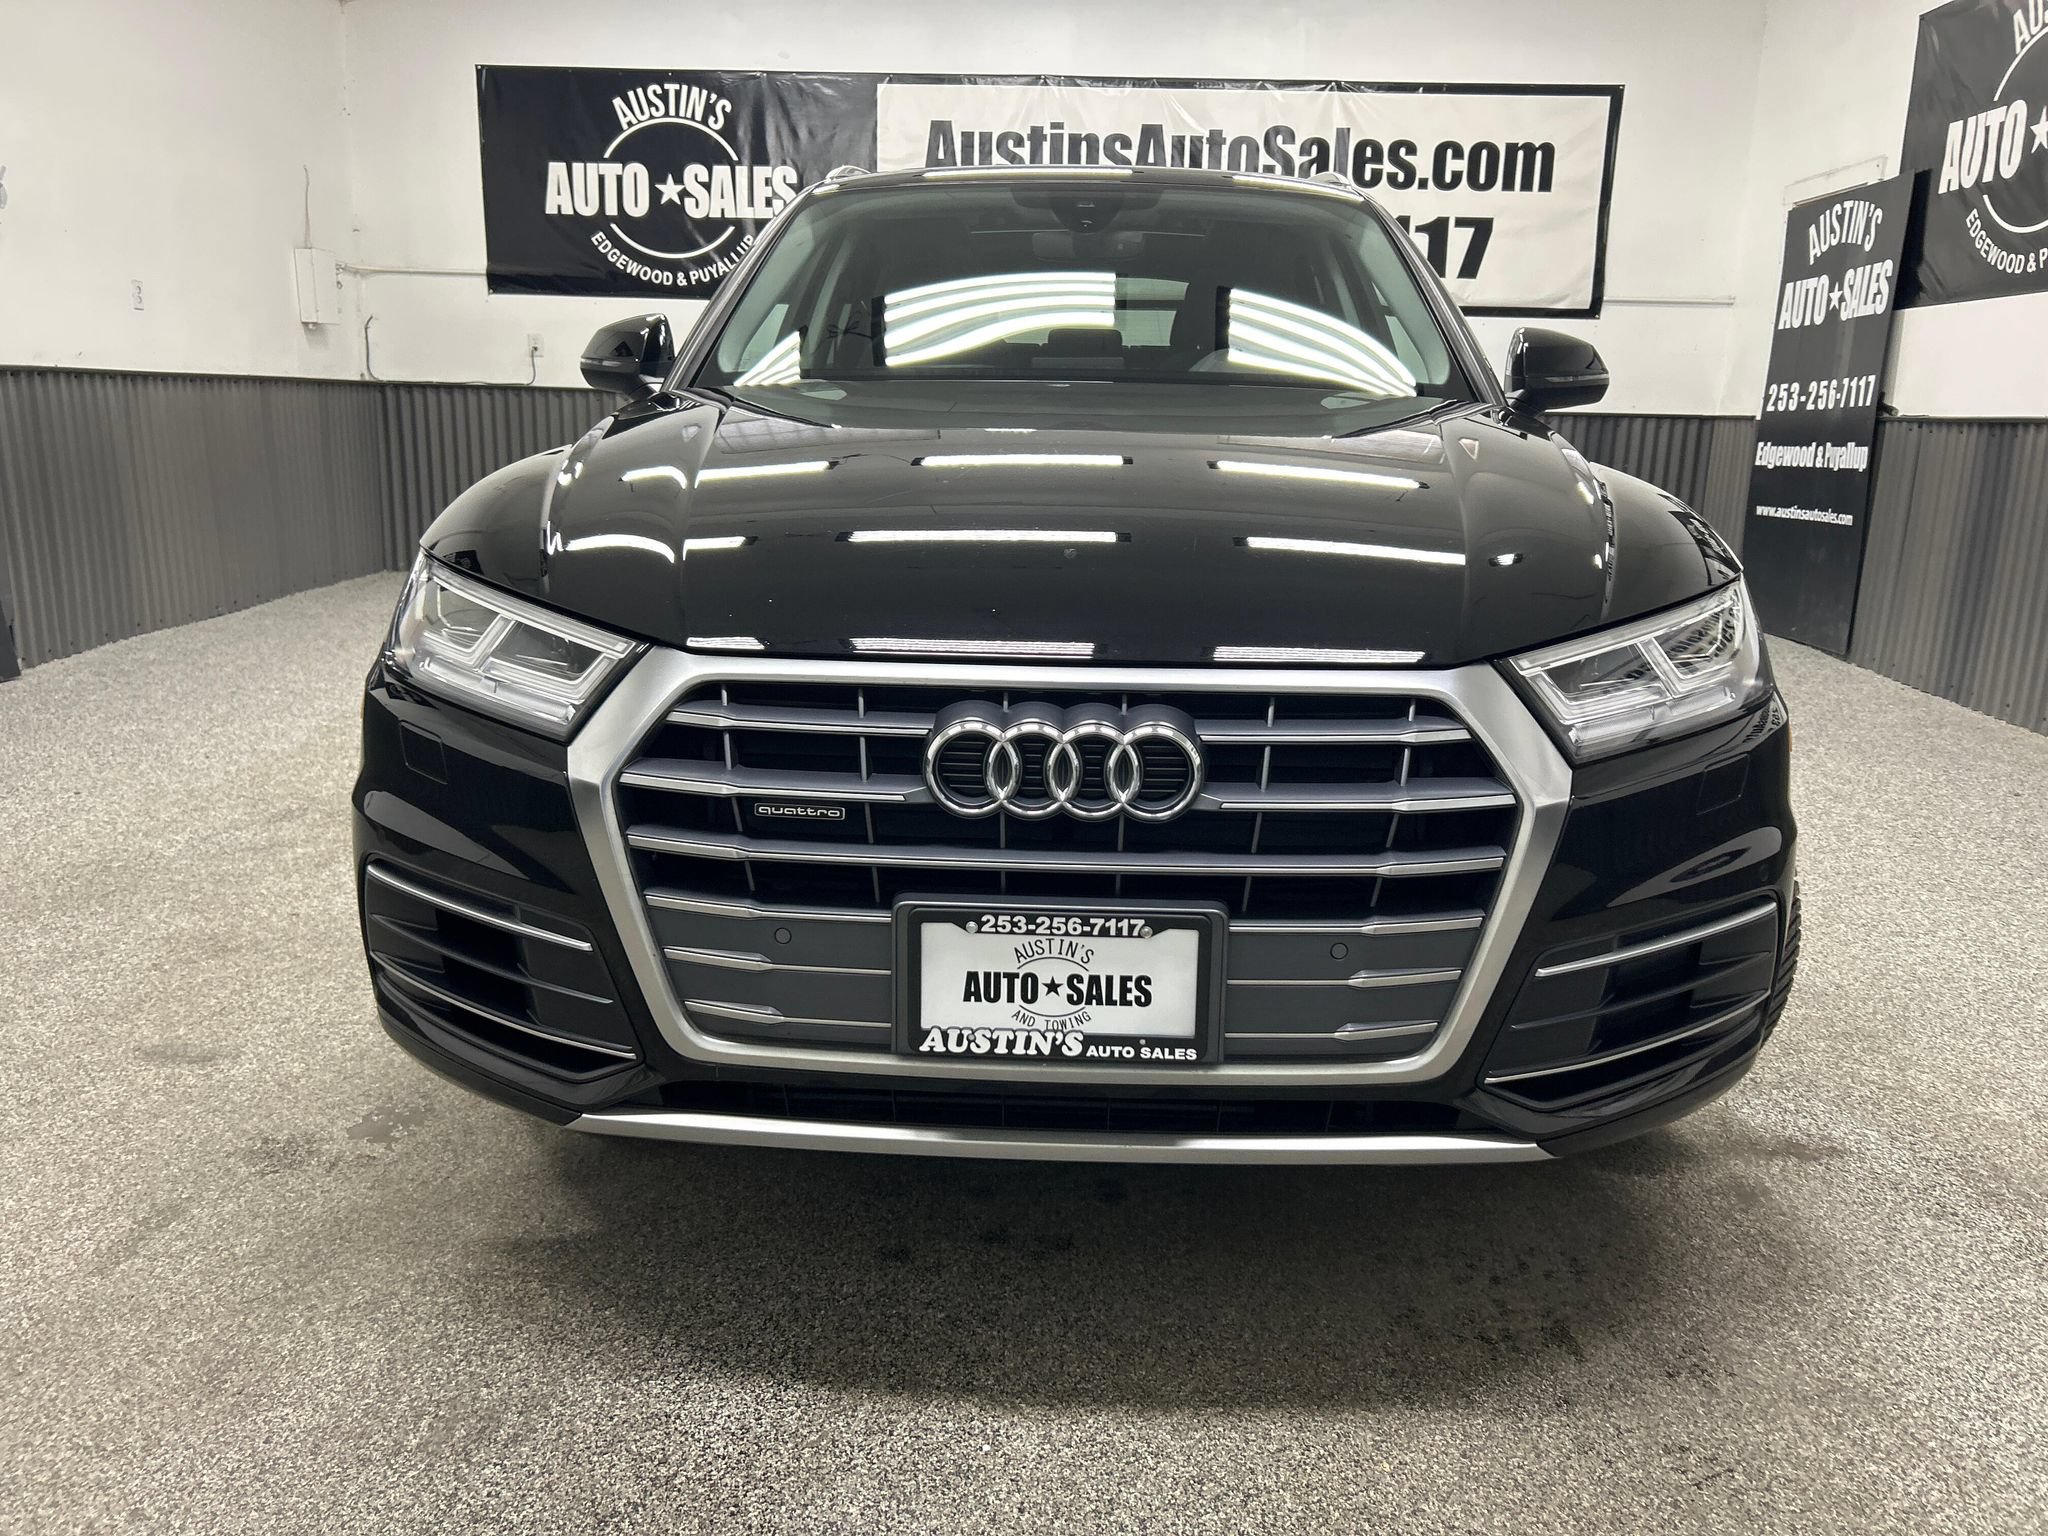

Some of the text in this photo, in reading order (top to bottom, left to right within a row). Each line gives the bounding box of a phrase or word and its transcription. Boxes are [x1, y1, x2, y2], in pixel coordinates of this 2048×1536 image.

[612, 83, 732, 131] AUSTIN'S
[925, 120, 1556, 193] AustinsAutoSales.com
[1938, 100, 2028, 194] AUTO
[545, 161, 798, 219] AUTO SALES
[1809, 200, 1883, 265] AUSTIN'S
[1966, 208, 2025, 274] EDGEWOOD
[2027, 252, 2037, 273] &
[591, 231, 673, 286] EDGEWOOD
[676, 272, 688, 286] &
[1778, 259, 1893, 330] AUTO SALES
[1766, 375, 1877, 412] 253-256-7117
[1755, 441, 1869, 472] Edgewood & Puyallup
[1756, 505, 1853, 526] www.austinsautosales.com
[758, 806, 840, 817] quattro
[980, 914, 1144, 937] 253-256-7117
[1013, 938, 1095, 965] AUSTIN'S
[963, 971, 1152, 1008] AUTO SALES
[1011, 1009, 1092, 1031] AND TOWING
[919, 1027, 1198, 1061] AUSTIN'S AUTO SALES
